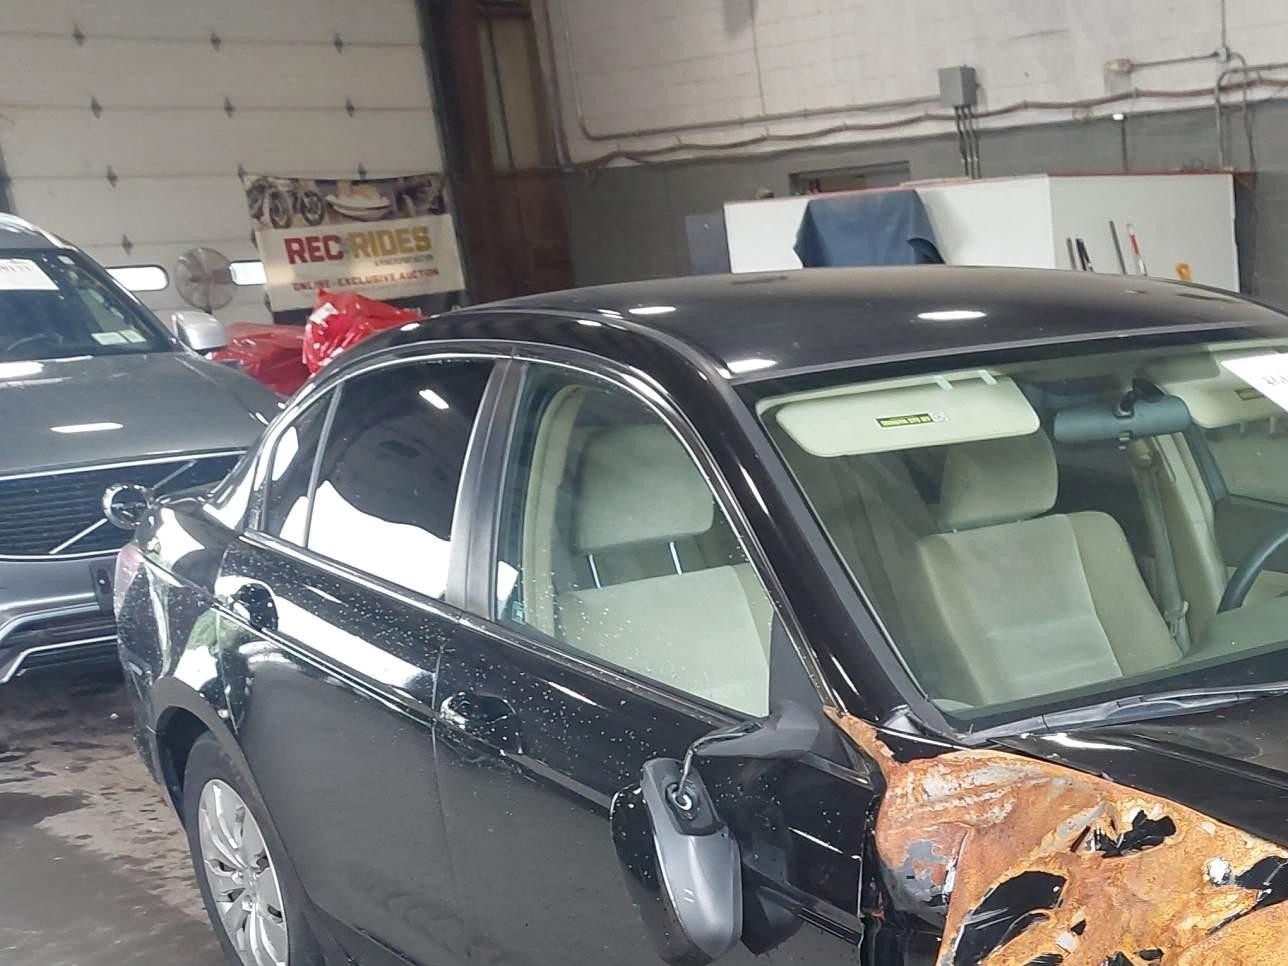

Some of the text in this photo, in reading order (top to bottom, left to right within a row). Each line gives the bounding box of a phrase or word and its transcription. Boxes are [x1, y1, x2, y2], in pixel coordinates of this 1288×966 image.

[284, 225, 432, 264] REC RIDES
[400, 268, 439, 280] AUCTION
